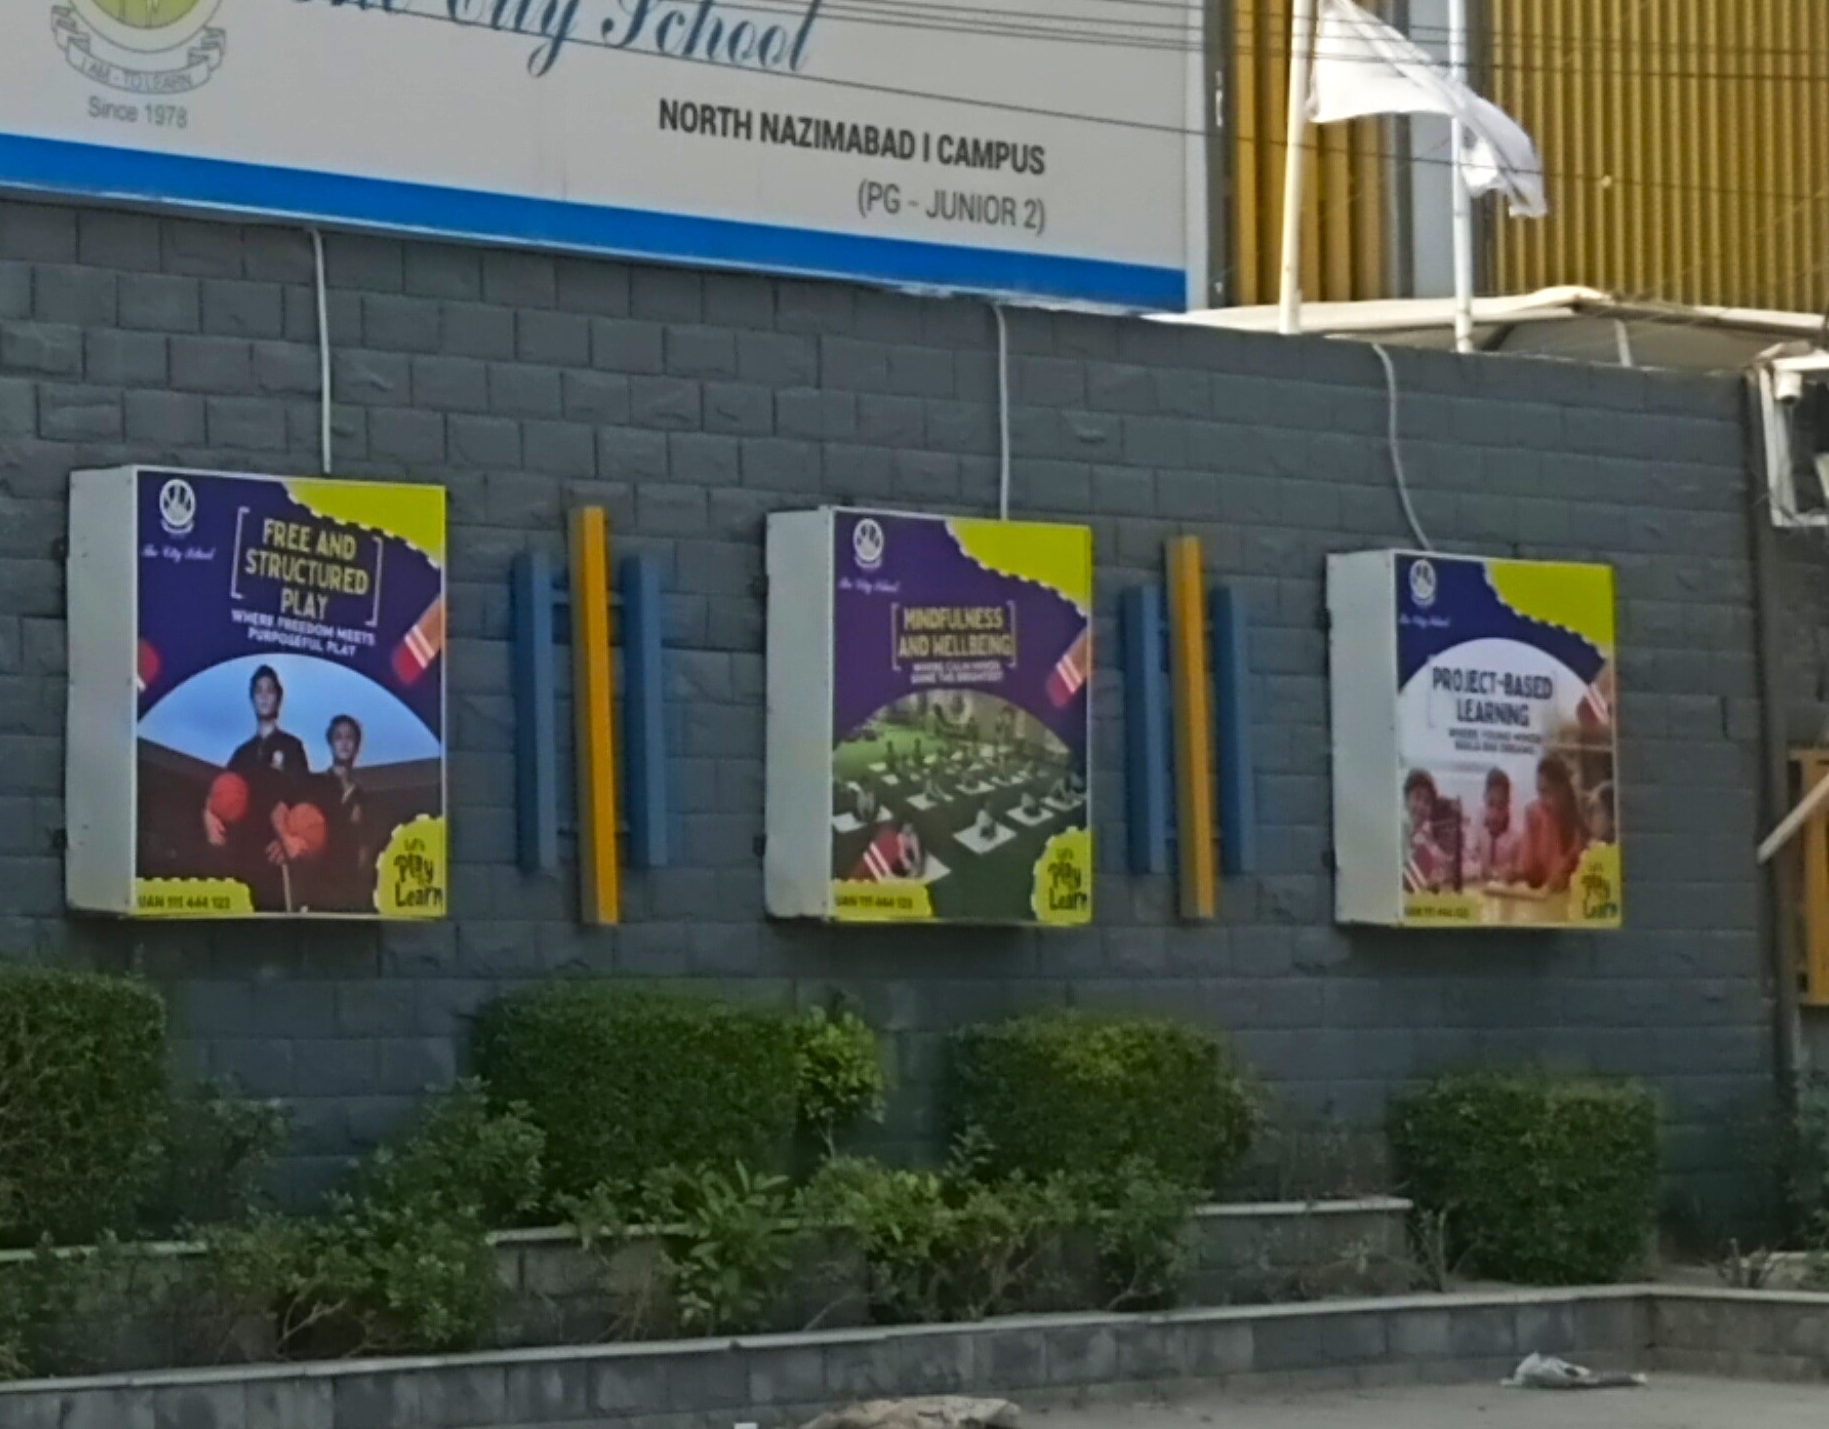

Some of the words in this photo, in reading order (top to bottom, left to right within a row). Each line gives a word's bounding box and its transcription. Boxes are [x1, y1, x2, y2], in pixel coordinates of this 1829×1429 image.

[88, 95, 138, 122] Since
[145, 103, 188, 129] 1978
[659, 98, 752, 140] NORTH
[760, 111, 915, 159] NAZIMABAD
[923, 132, 930, 162] I
[937, 134, 1045, 175] CAMPUS
[858, 179, 900, 218] (PG
[926, 189, 1016, 227] JUNIOR
[1023, 198, 1046, 236] 2)
[263, 518, 311, 553] FREE
[316, 530, 357, 561] AND
[245, 548, 369, 595] STRUCTURED
[281, 587, 328, 620] PLAY
[904, 606, 1003, 630] MINDFULNESS
[898, 634, 929, 657] AND
[933, 634, 1013, 656] WELLBEING
[1433, 667, 1553, 700] PROJECT-BASED
[1457, 698, 1529, 727] LEARNING
[395, 881, 443, 907] Learn
